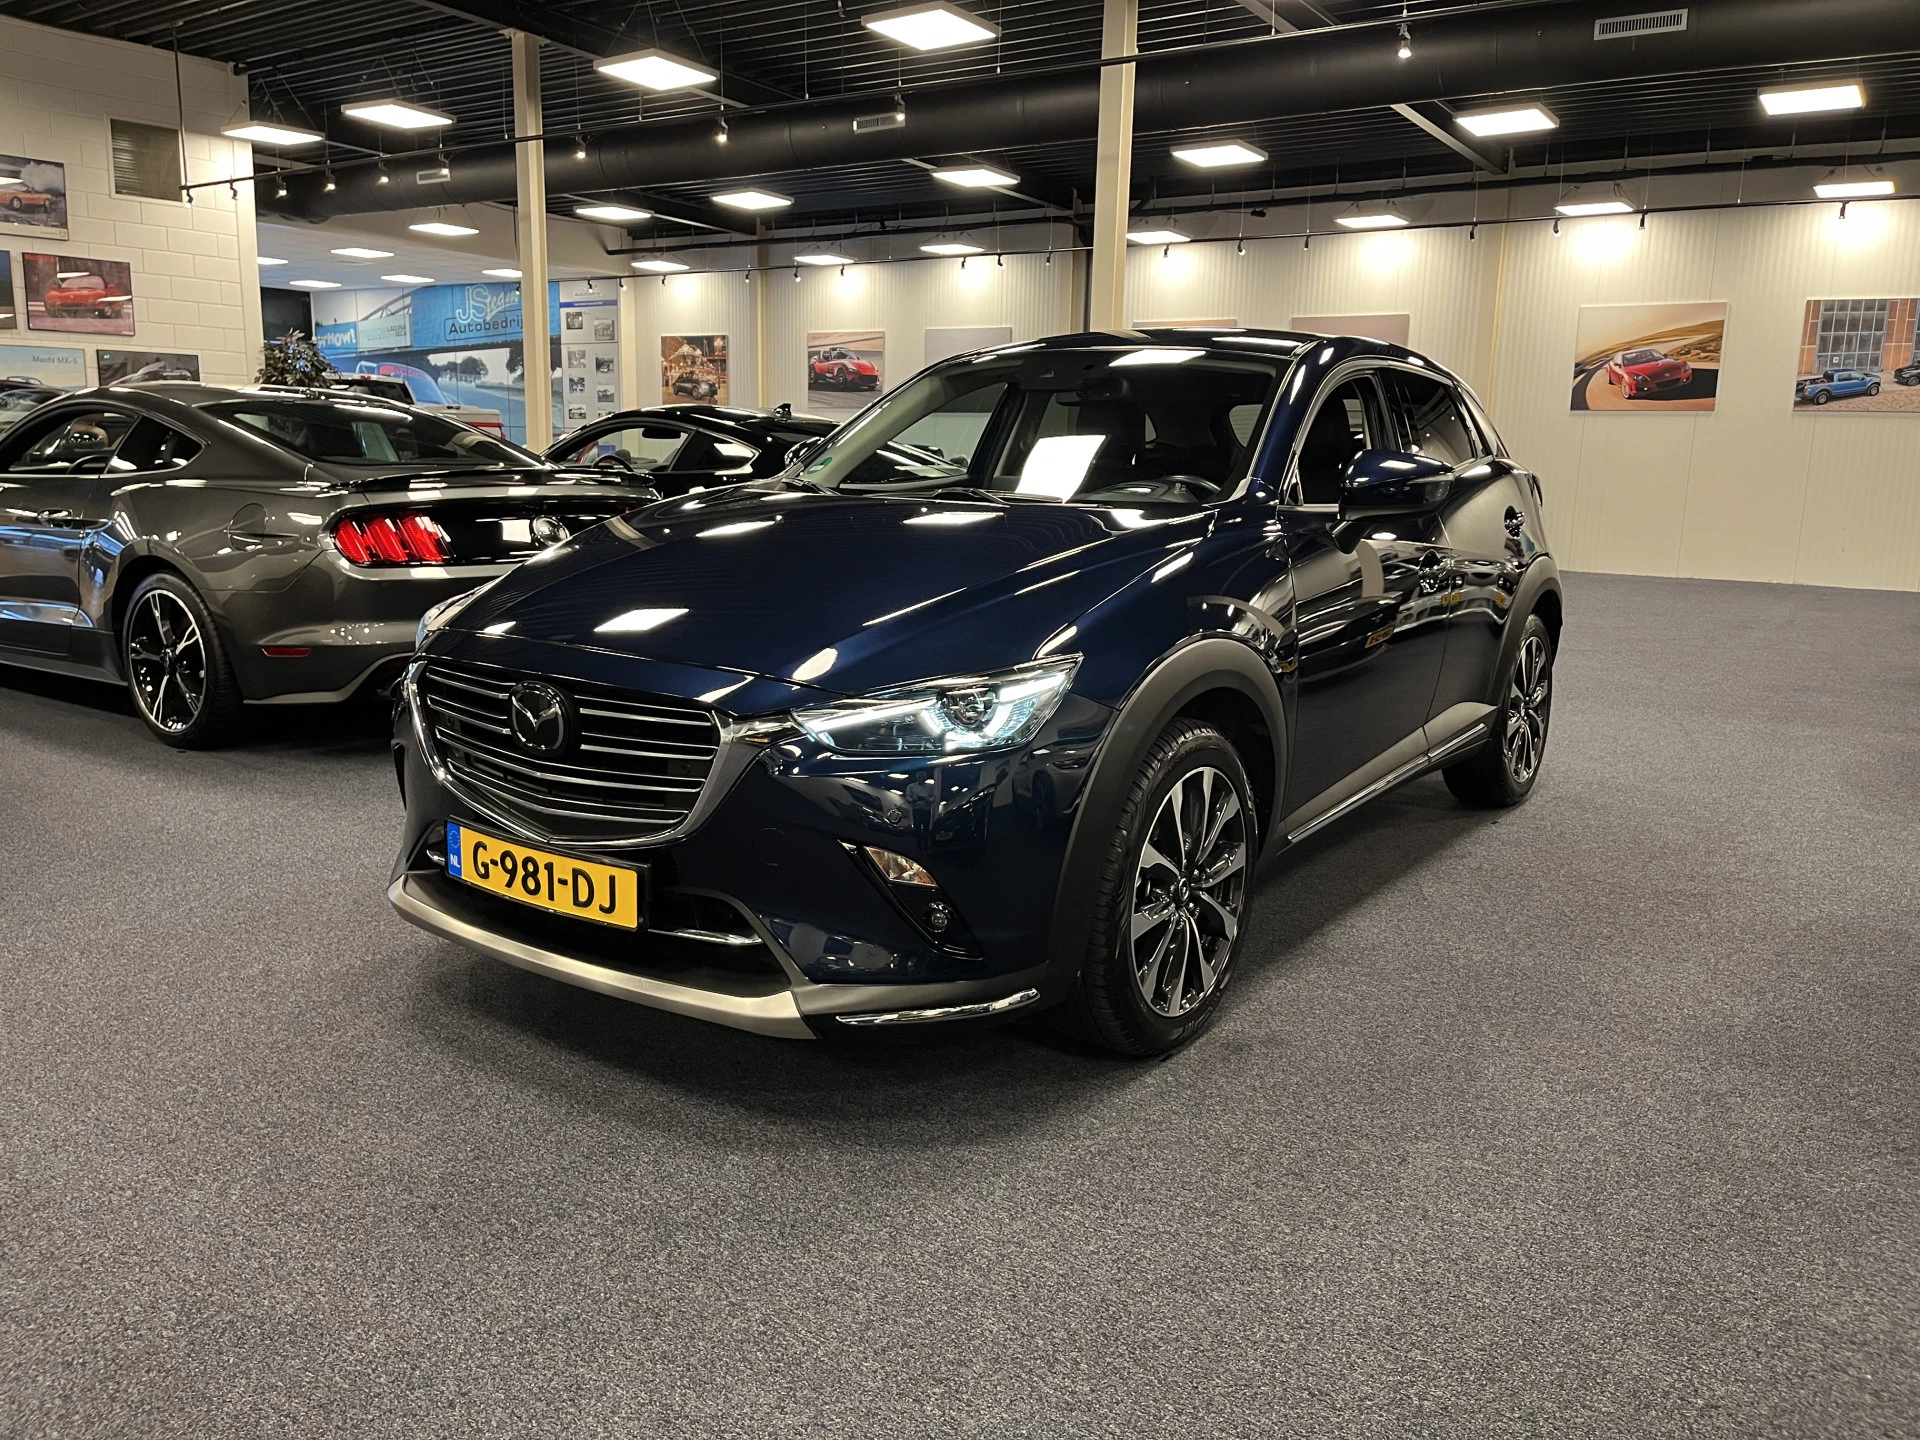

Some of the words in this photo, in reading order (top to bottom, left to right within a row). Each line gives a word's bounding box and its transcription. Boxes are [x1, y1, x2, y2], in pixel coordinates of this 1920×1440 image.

[449, 315, 523, 335] Autobedrij
[32, 355, 55, 363] Mazda
[57, 356, 78, 364] MX-5
[450, 854, 460, 868] NL
[472, 840, 616, 914] G-981-DJ
